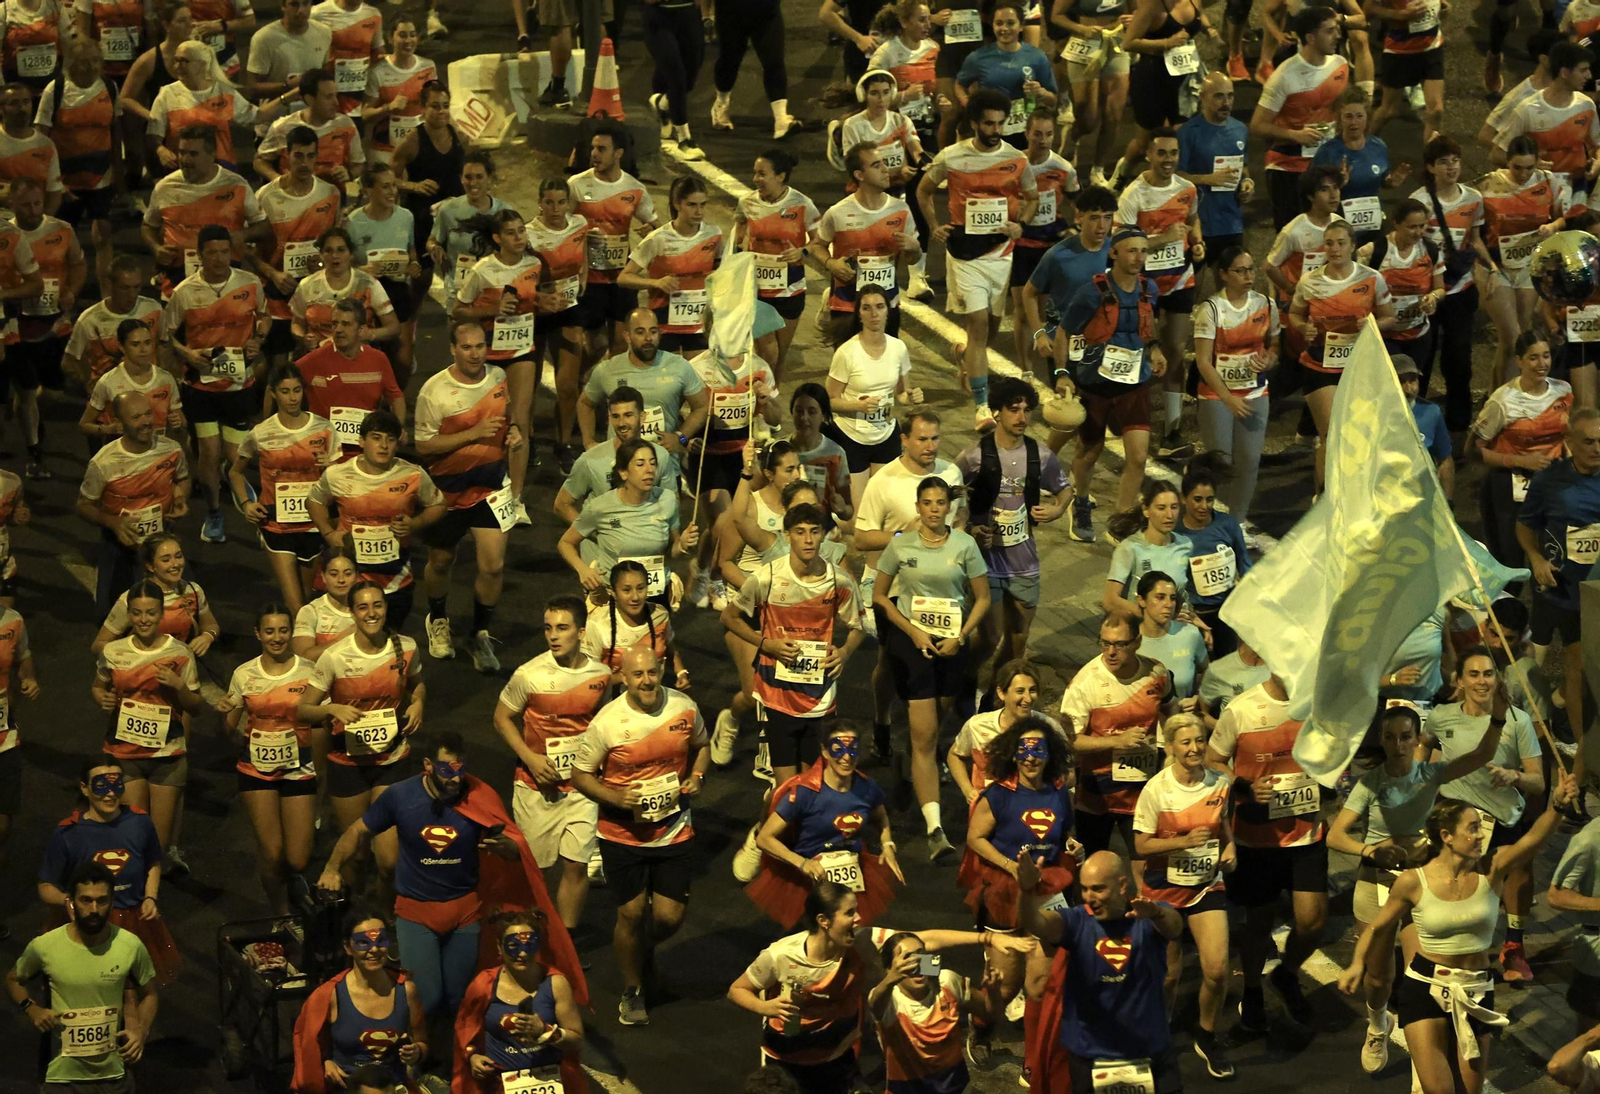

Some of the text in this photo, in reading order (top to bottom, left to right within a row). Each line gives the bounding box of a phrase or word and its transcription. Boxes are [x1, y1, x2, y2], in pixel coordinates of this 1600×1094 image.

[951, 23, 974, 34] 9708
[22, 56, 53, 68] 12886
[339, 71, 365, 83] 20962
[971, 213, 1003, 224] 13804
[1352, 211, 1374, 224] 2057
[1153, 246, 1177, 260] 3783
[756, 267, 782, 280] 3004
[862, 270, 891, 281] 19474
[674, 303, 706, 316] 17947
[498, 328, 529, 341] 21764
[993, 521, 1024, 537] 22057
[358, 538, 393, 553] 13161
[1203, 566, 1230, 584] 1852
[921, 613, 951, 627] 8816
[126, 717, 158, 735] 9363
[355, 727, 388, 743] 6623
[256, 746, 292, 761] 12313
[1118, 754, 1154, 770] 24012
[642, 792, 671, 812] 6625
[1275, 788, 1313, 806] 12710
[1175, 857, 1212, 873] 12648
[69, 1025, 110, 1043] 15684
